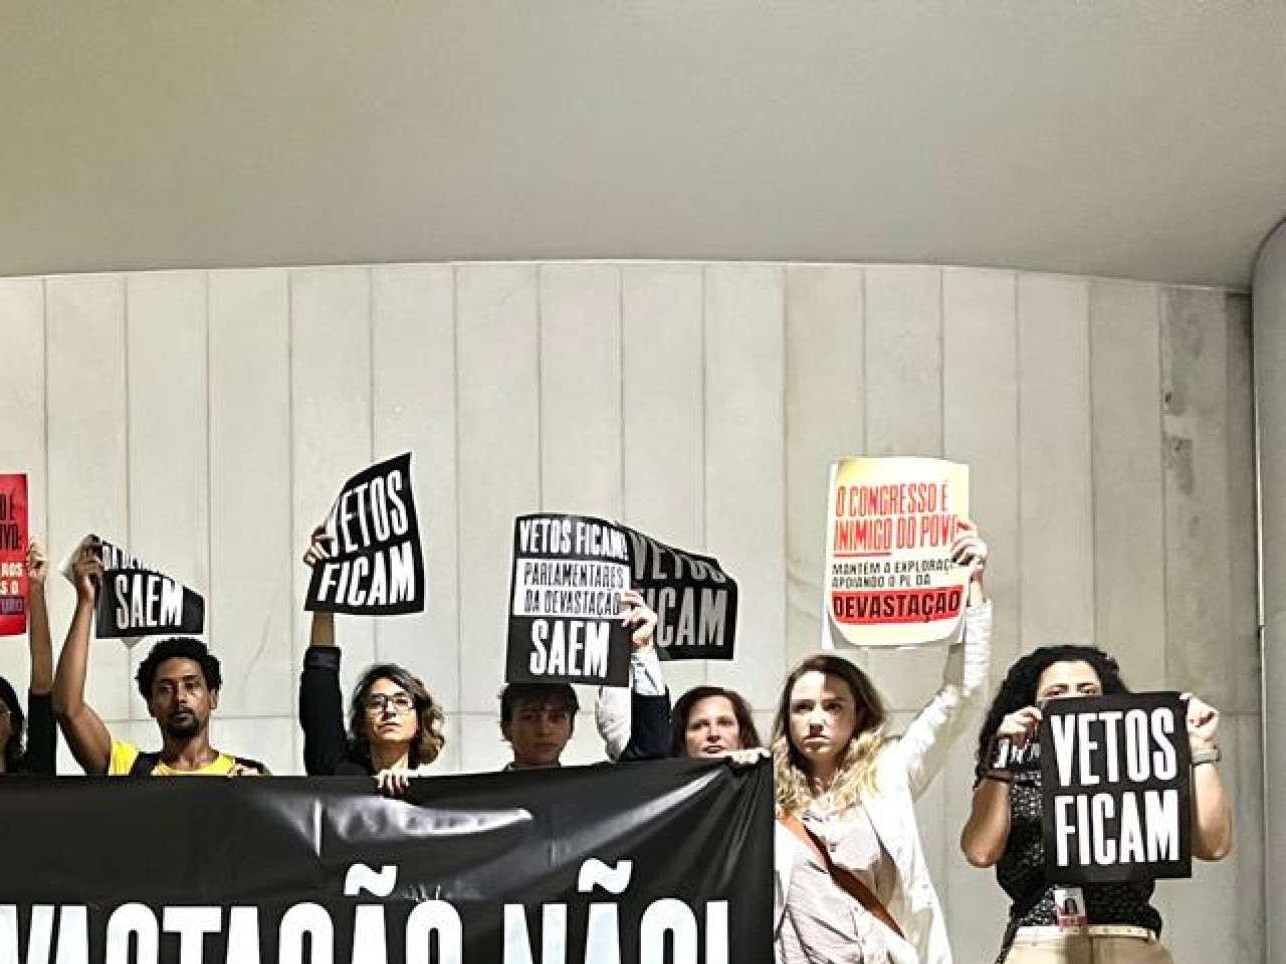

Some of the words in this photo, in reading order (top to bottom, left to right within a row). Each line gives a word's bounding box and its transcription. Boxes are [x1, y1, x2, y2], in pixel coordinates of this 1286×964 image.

[836, 486, 846, 517] O
[850, 483, 937, 517] CONGRESSO
[520, 519, 572, 554] VETOS
[834, 518, 892, 552] INIMIGO
[896, 515, 915, 549] DO
[317, 541, 415, 606] FICAM
[524, 562, 624, 588] PARLAMENTARES
[832, 575, 885, 589] APOIANDO
[900, 574, 911, 587] PL
[916, 574, 931, 586] DA
[895, 558, 953, 575] EXPLORAÇ
[115, 574, 183, 629] SAEM
[524, 589, 539, 612] DA
[646, 586, 727, 647] CAM
[529, 618, 610, 678] SAEM
[1050, 707, 1179, 787] VETOS
[1055, 789, 1180, 867] FICAM
